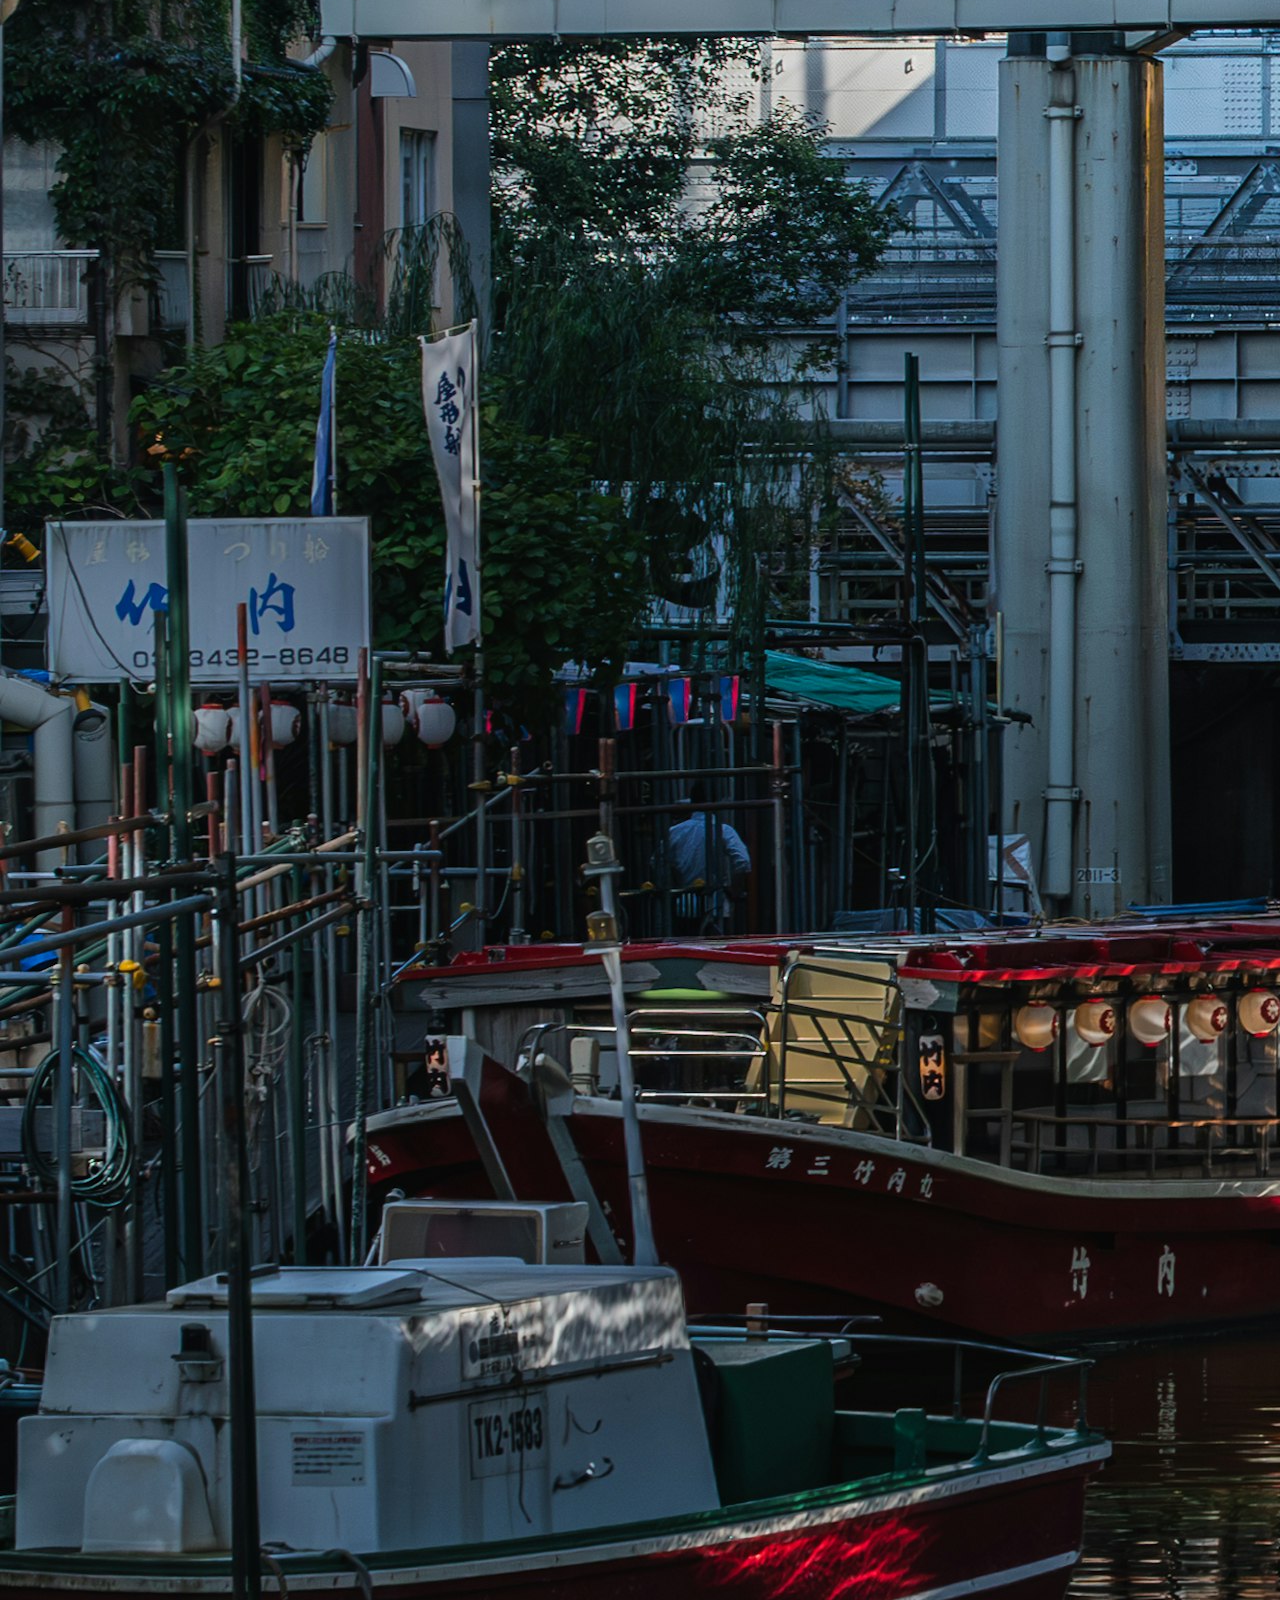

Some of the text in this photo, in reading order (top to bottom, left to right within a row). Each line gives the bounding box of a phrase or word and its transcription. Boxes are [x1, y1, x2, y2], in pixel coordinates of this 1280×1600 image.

[133, 646, 349, 669] 03432-8648
[919, 1041, 943, 1095] 竹内
[765, 1146, 934, 1199] 第三竹内丸
[1070, 1244, 1176, 1300] 竹内
